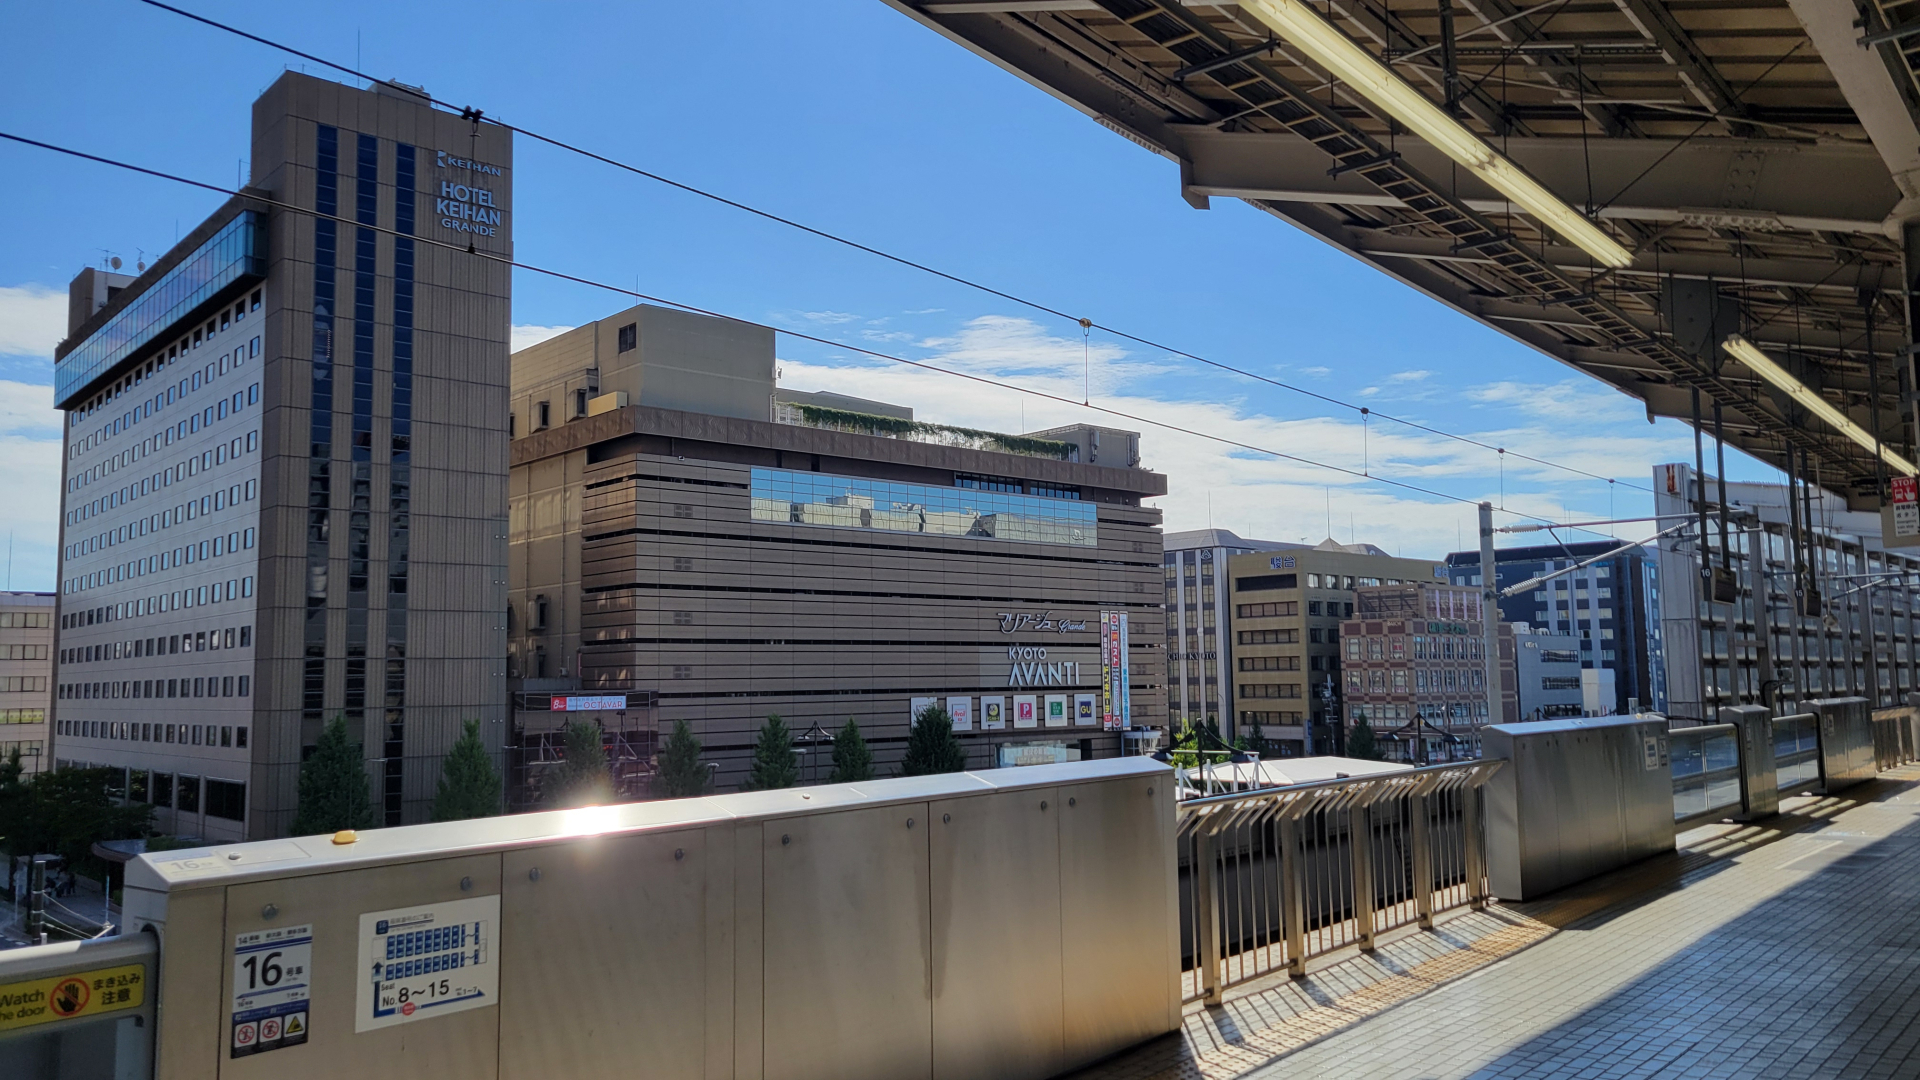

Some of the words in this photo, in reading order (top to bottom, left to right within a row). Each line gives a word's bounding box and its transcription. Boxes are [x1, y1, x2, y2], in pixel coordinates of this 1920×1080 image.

[447, 156, 501, 177] KEIHAN
[441, 180, 496, 208] HOTEL
[436, 197, 501, 227] KEIHAN
[441, 218, 497, 238] GRANDE
[1893, 479, 1915, 488] STOP
[1701, 568, 1711, 577] 16
[997, 611, 1056, 634] マリアージュ
[1008, 646, 1047, 660] KYOTO
[1008, 661, 1080, 686] AVANTI
[584, 701, 623, 709] OCTAVAR
[1080, 705, 1091, 714] GU
[171, 860, 200, 870] 16
[242, 951, 283, 990] 16
[93, 972, 141, 991] まき込み
[381, 982, 396, 992] Seat
[101, 987, 132, 1006] 注意
[17, 1006, 46, 1018] door
